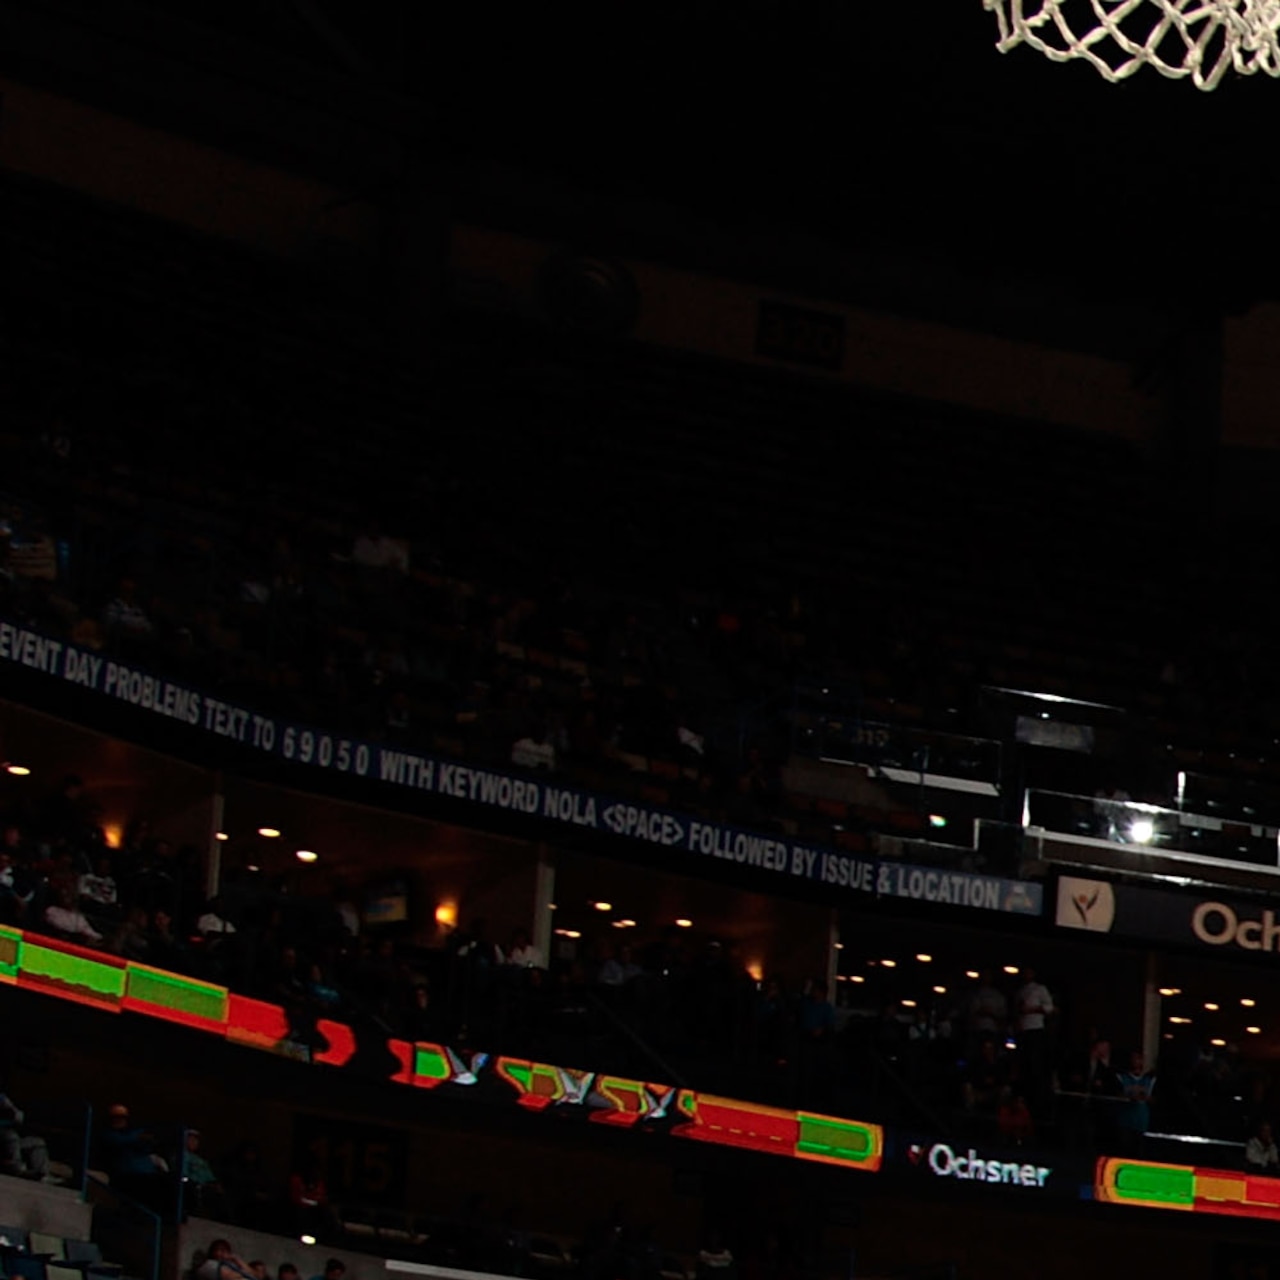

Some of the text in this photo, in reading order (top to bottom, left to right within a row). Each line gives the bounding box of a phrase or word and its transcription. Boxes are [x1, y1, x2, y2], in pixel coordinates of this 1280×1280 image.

[0, 622, 62, 674] EVENT
[64, 646, 102, 689] DAY
[104, 661, 201, 725] PROBLEMS
[204, 697, 249, 742] TEXT
[252, 714, 275, 752] TO
[379, 746, 434, 790] WITH
[438, 761, 539, 815] KEYWORD
[544, 787, 599, 828] NOLA
[689, 821, 787, 874] FOLLOWED
[791, 844, 820, 880] BY
[821, 851, 875, 892] ISSUE
[877, 861, 892, 894] &
[896, 865, 1000, 911] LOCATION
[926, 1142, 1051, 1188] Ochsner
